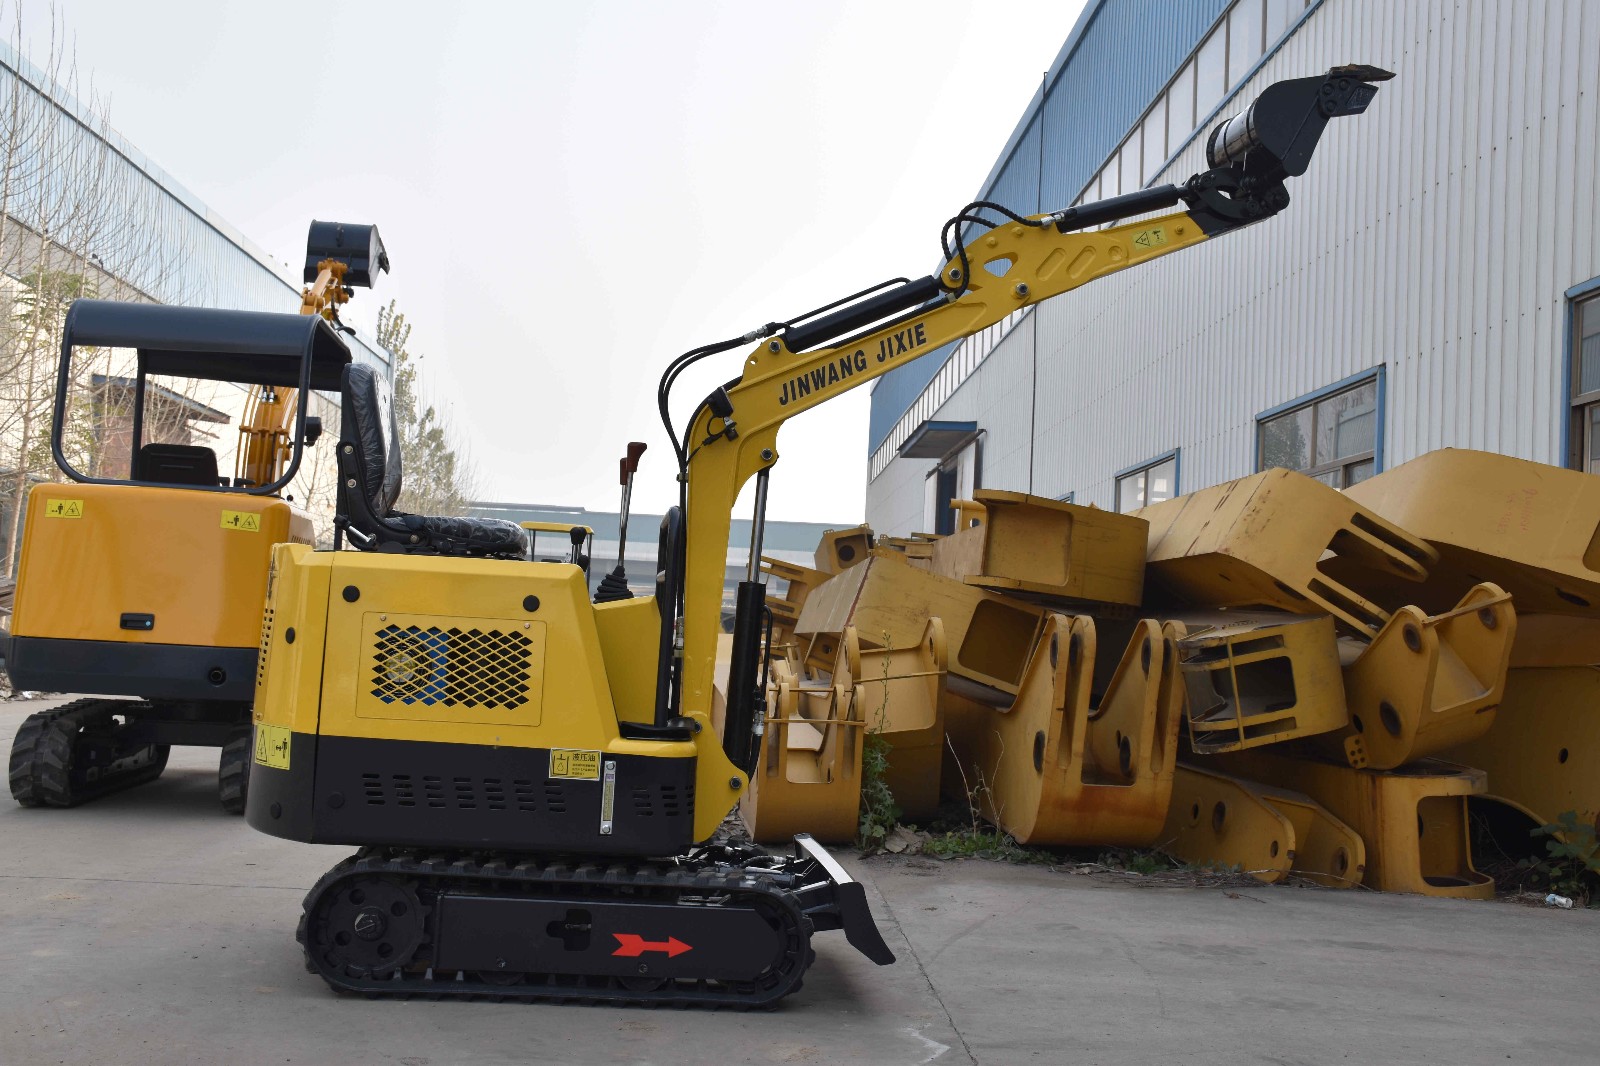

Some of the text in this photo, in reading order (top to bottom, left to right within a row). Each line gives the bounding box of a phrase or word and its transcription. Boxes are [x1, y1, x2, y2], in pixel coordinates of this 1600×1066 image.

[779, 322, 927, 406] JINWANG JIXIE
[572, 752, 596, 762] 液压油
